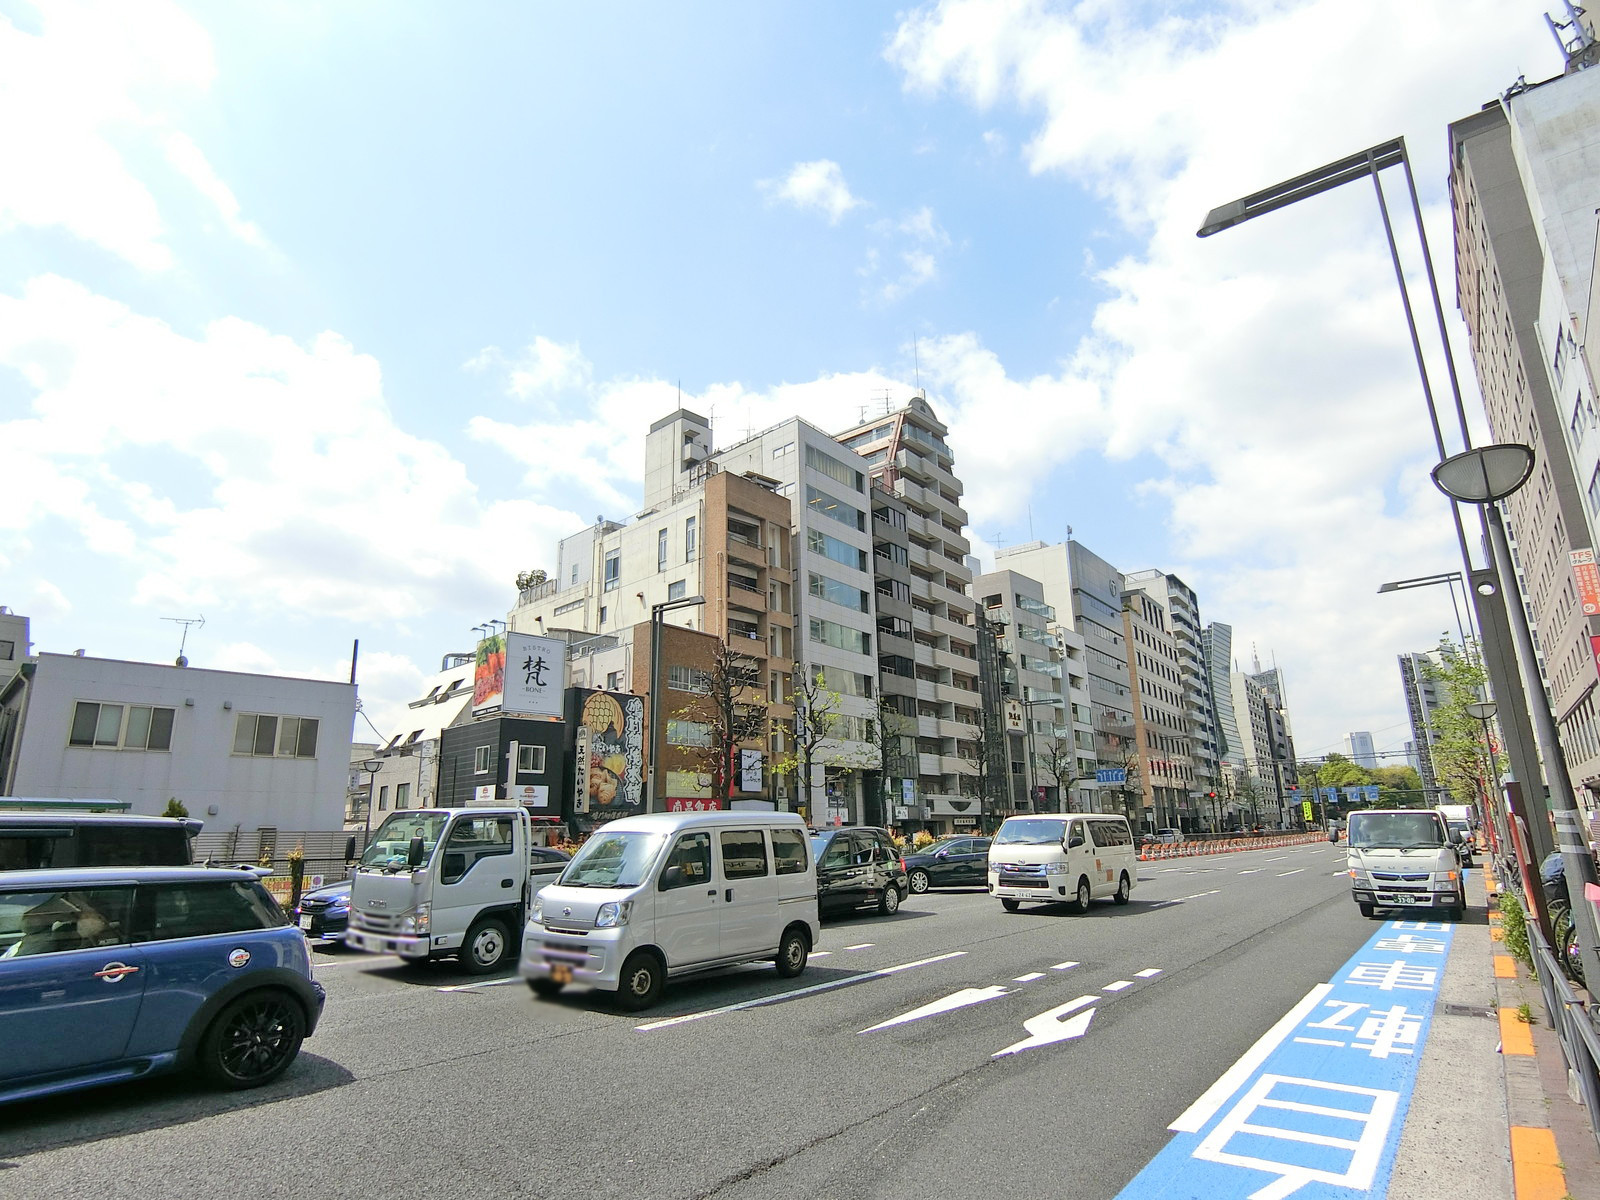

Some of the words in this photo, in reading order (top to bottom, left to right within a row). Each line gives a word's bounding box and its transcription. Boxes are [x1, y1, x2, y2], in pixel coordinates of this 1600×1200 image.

[1570, 551, 1592, 559] TFS
[523, 645, 551, 655] BISTRO
[522, 655, 550, 687] 梵
[576, 745, 585, 809] 天然たいやき
